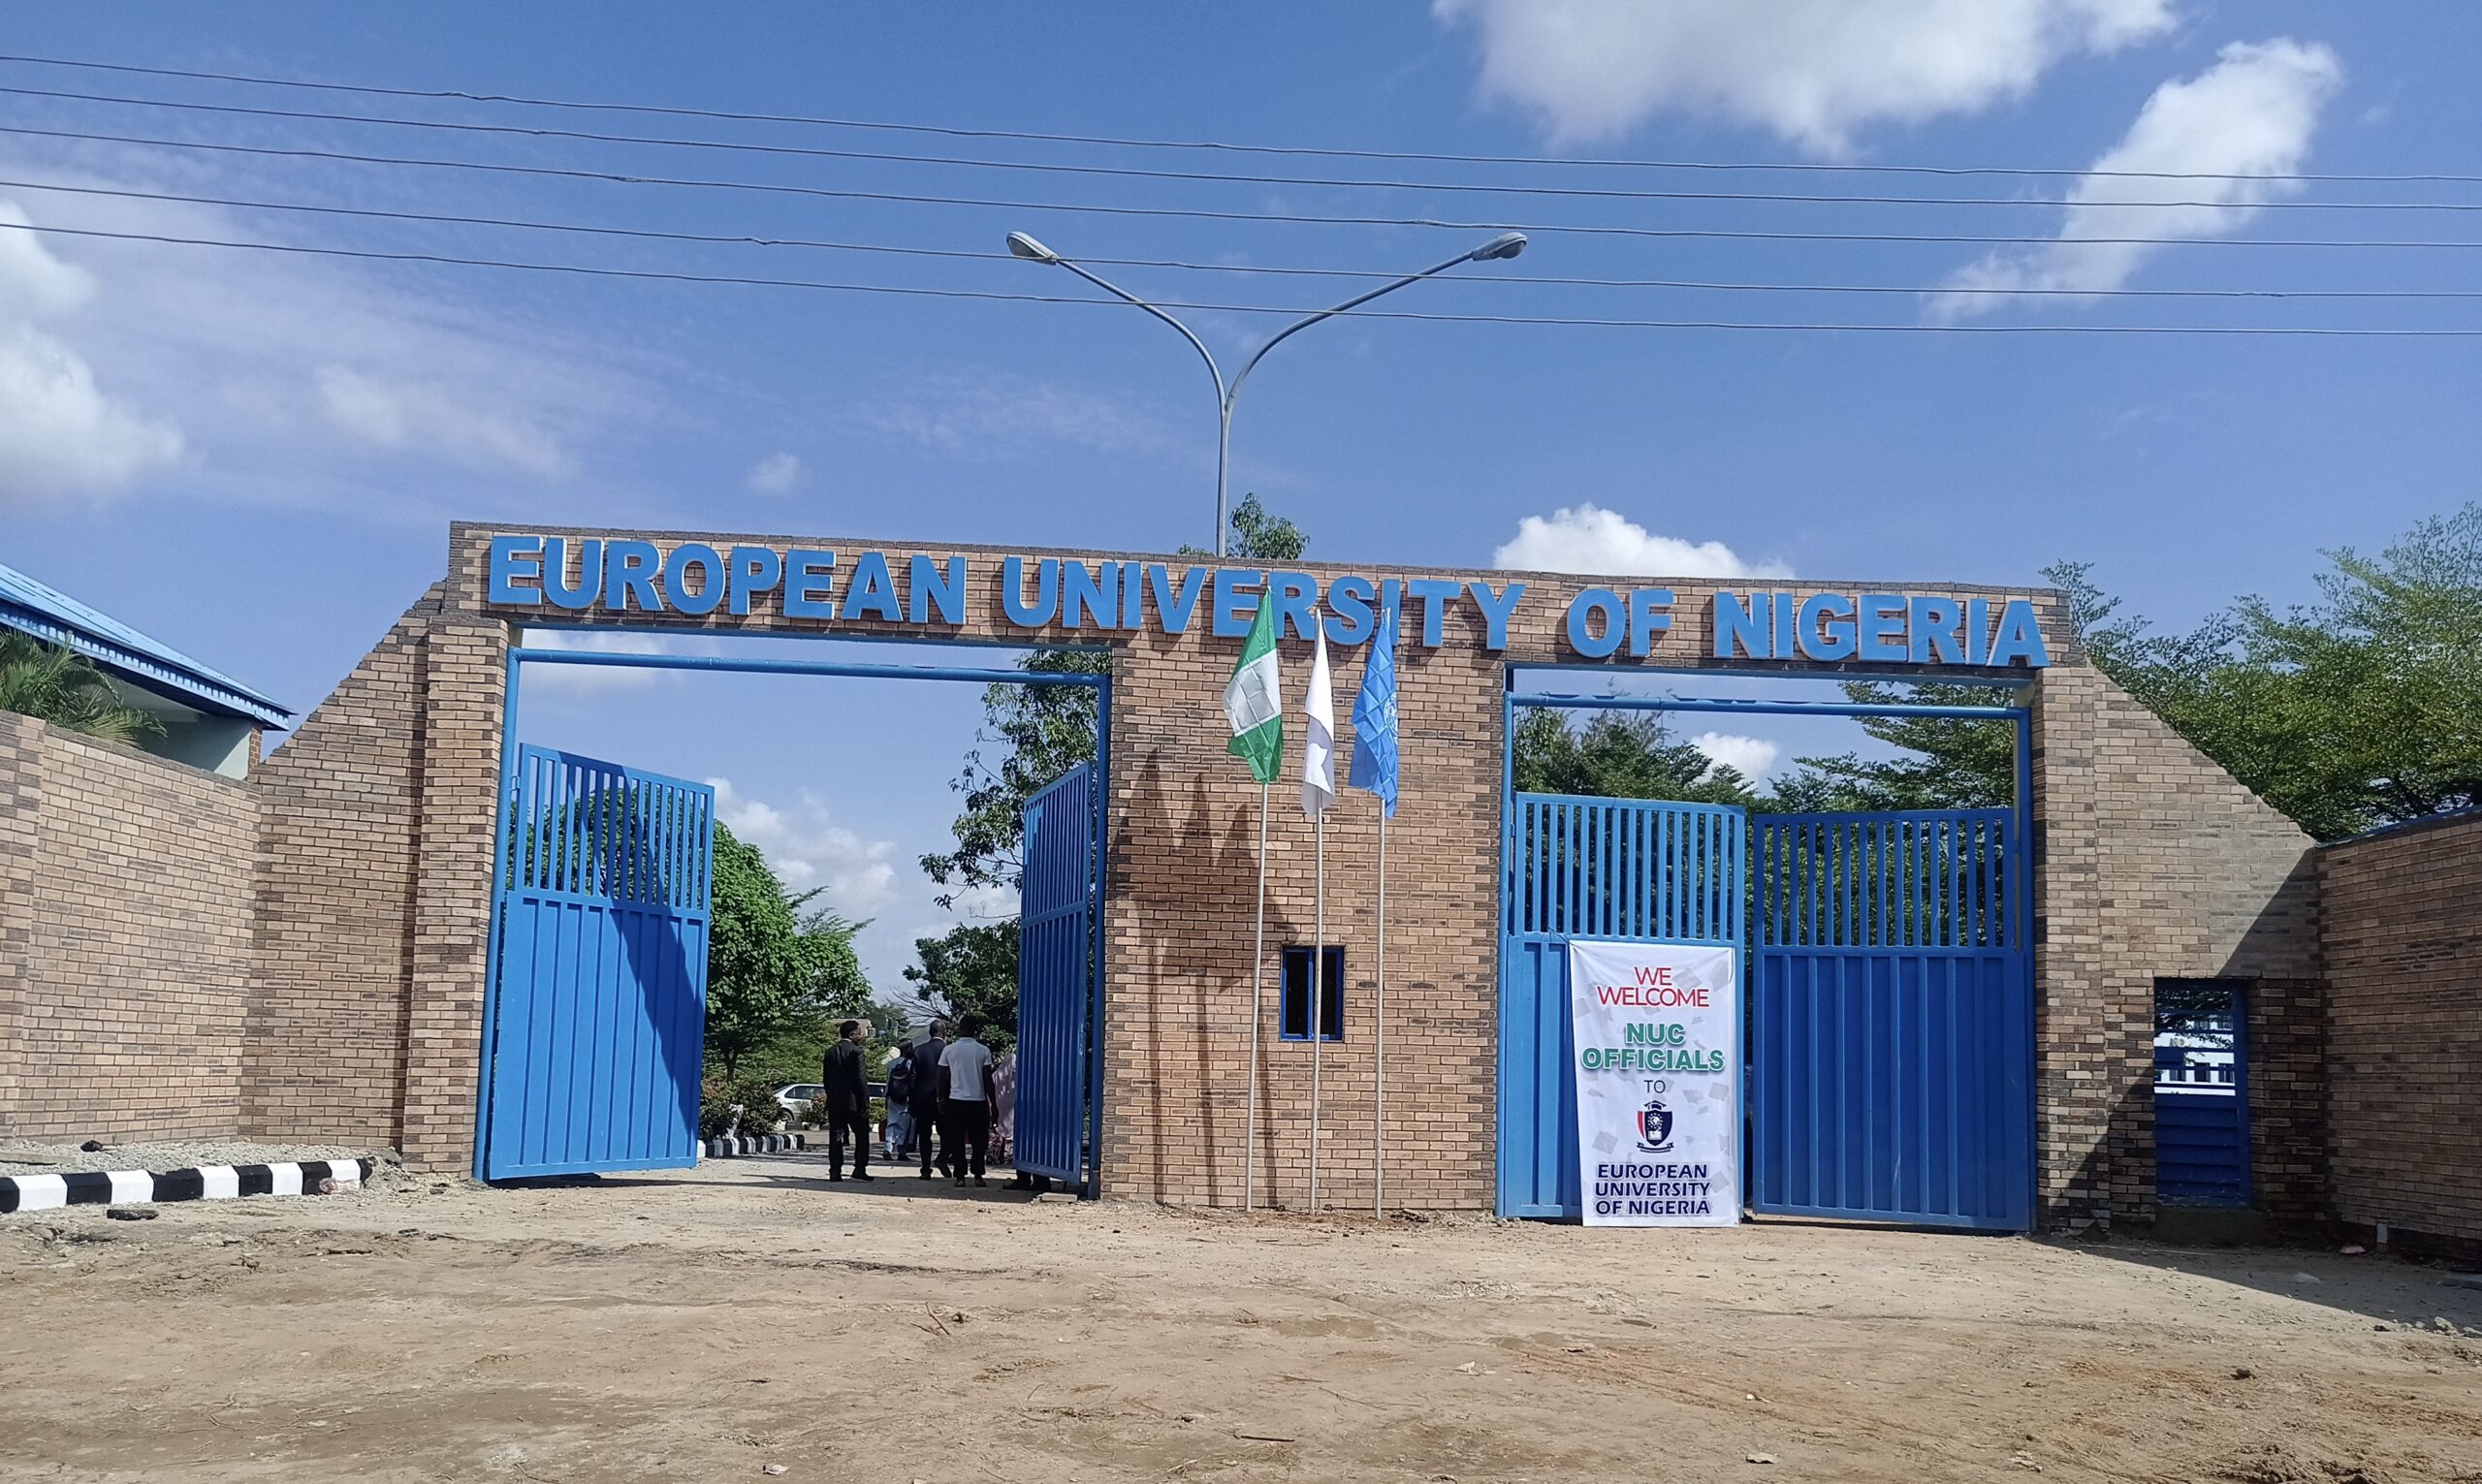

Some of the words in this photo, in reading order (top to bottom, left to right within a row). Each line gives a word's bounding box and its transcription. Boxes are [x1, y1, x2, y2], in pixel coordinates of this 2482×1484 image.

[489, 534, 967, 625] EUROPEAN
[1002, 556, 1526, 650] UNIVERSITY
[1567, 587, 1676, 659] OF
[1713, 591, 2051, 668] NIGERIA
[1634, 966, 1672, 987] WE
[1597, 986, 1709, 1007] WELCOME
[1626, 1023, 1685, 1045] NUC
[1581, 1048, 1725, 1071] OFFICIALS
[1643, 1080, 1666, 1094] TO
[1598, 1164, 1707, 1179] EUROPEAN
[1595, 1182, 1711, 1197] UNIVERSITY
[1596, 1200, 1622, 1215] OF
[1628, 1200, 1710, 1215] NIGERIA
